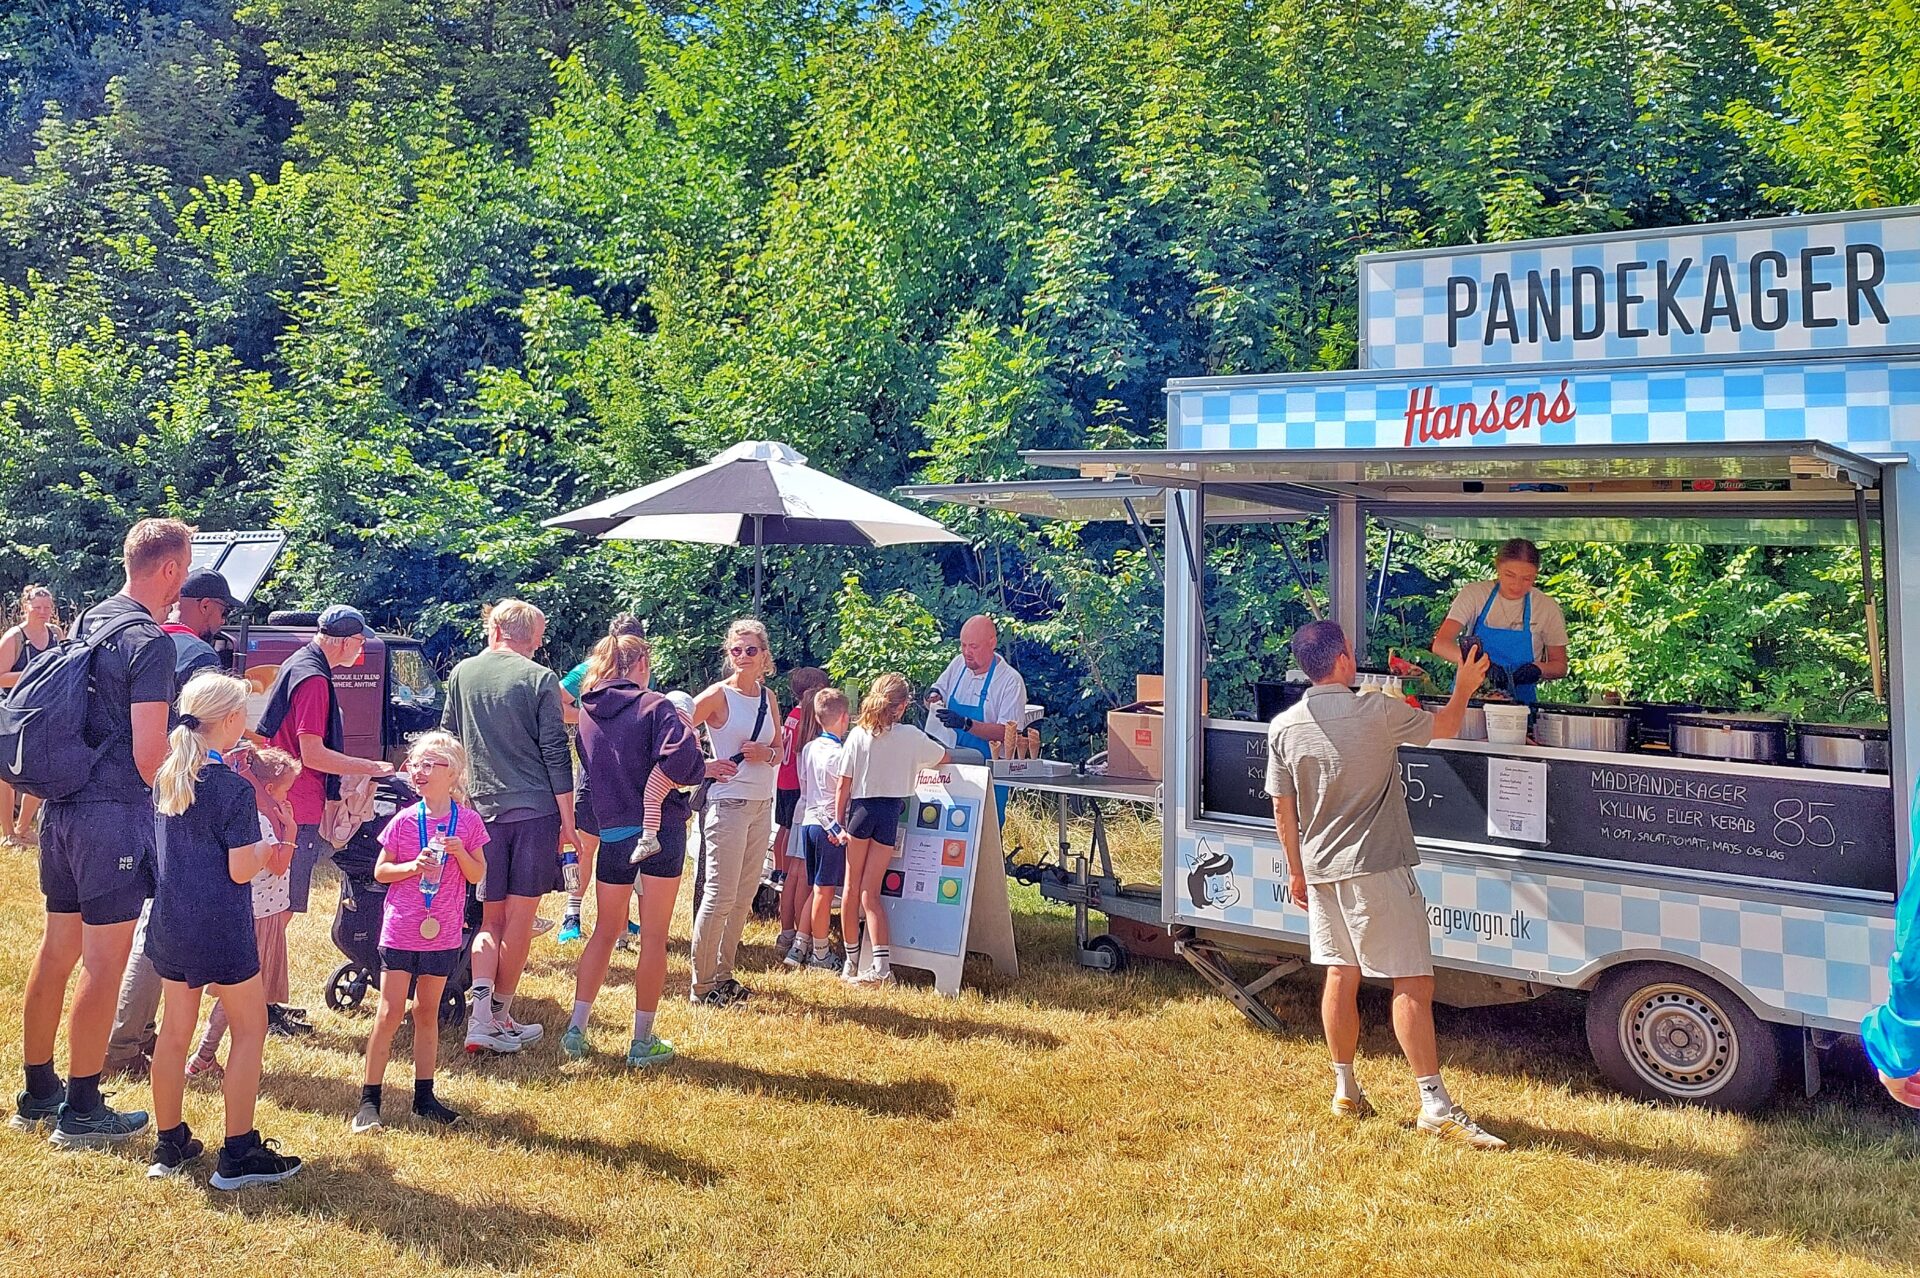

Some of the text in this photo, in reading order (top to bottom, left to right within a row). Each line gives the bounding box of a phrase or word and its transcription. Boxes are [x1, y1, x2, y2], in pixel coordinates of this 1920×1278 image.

[1447, 243, 1890, 348] PANDEKAGER
[1404, 378, 1577, 446] Hansens
[1258, 790, 1270, 800] OS
[1591, 769, 1748, 803] MADPANDEKAGER
[1598, 798, 1657, 823] KYLLING
[1667, 807, 1704, 828] ELLER
[1710, 814, 1757, 834] KEBAB
[1713, 841, 1742, 855] MAJS
[1746, 845, 1763, 857] OG
[1272, 857, 1282, 878] lej
[1423, 896, 1531, 941] kagevogn.dk
